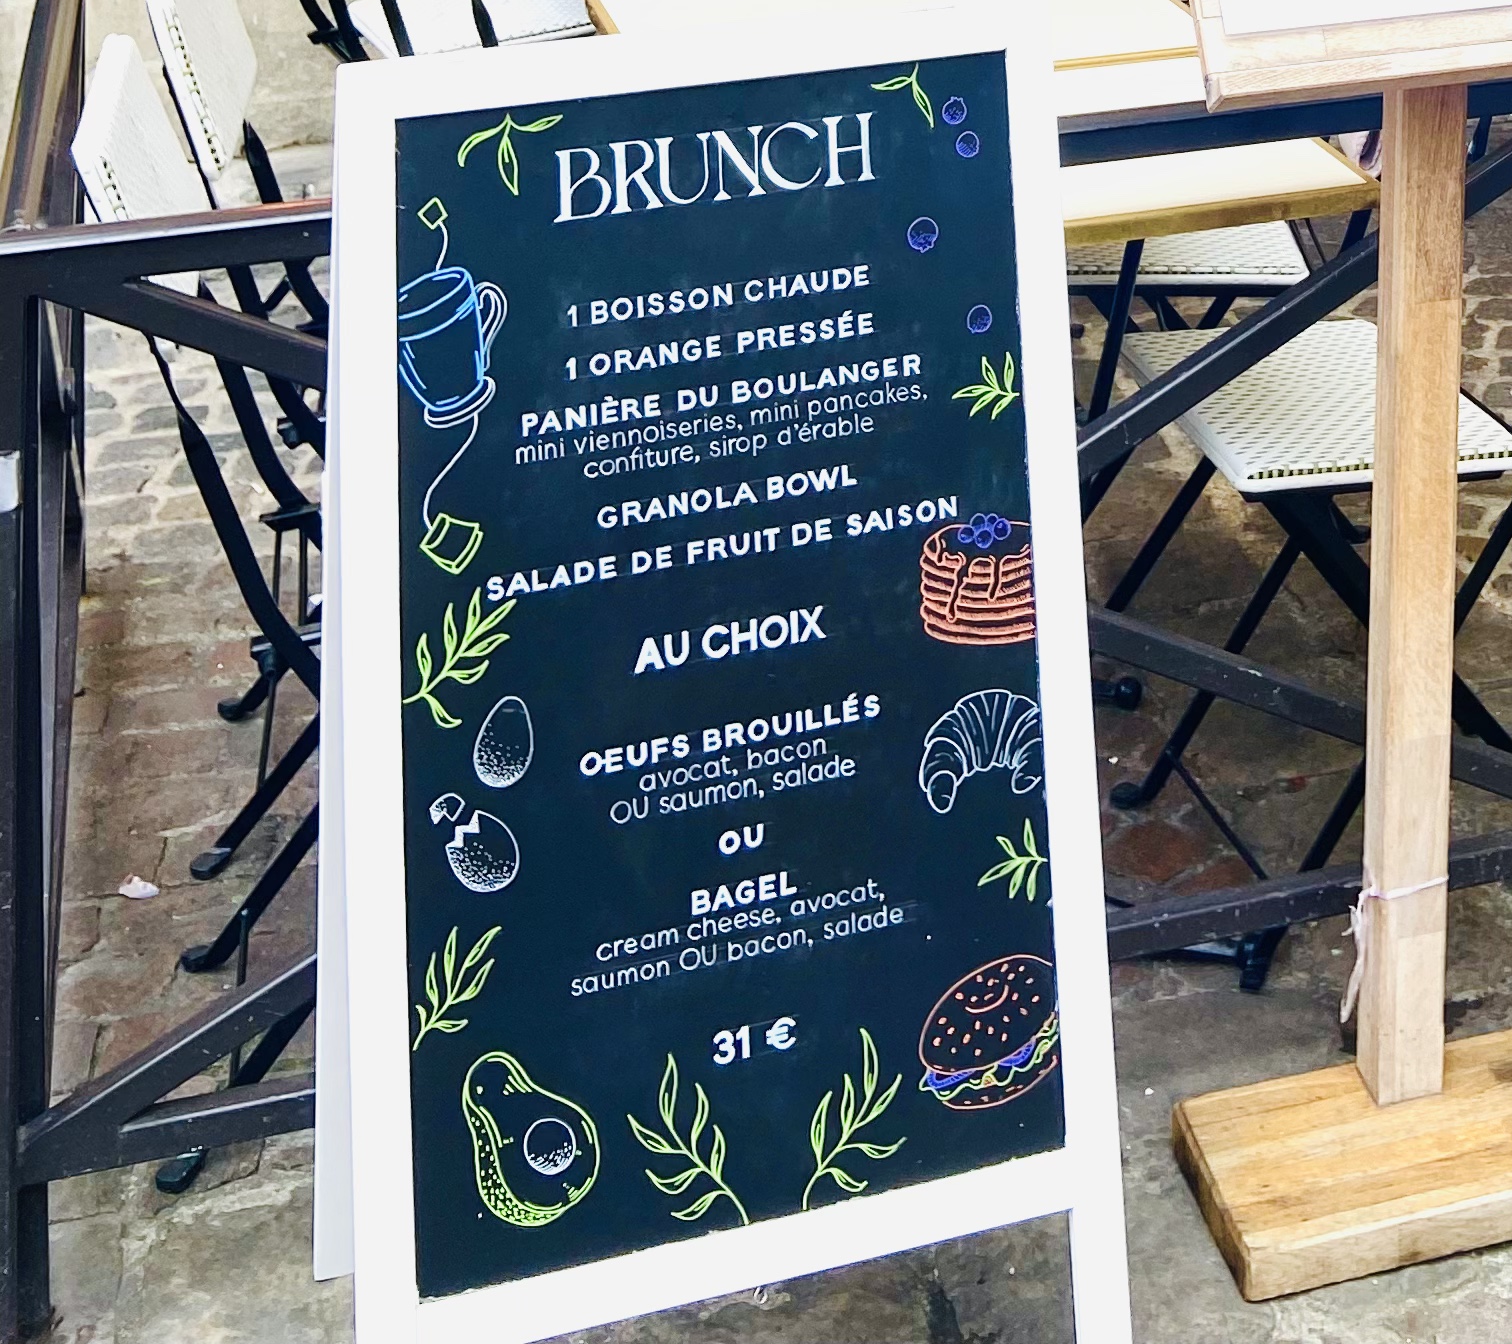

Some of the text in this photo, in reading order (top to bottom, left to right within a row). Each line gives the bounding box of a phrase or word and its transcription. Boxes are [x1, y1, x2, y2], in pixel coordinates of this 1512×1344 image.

[554, 112, 876, 224] BRUNCH
[567, 264, 871, 327] 1 BOISSON CHAUDE
[565, 311, 874, 380] 1 ORANGE PRESSÉE
[515, 381, 928, 465] mini viennoiseries, mini pancakes,
[520, 354, 922, 437] PANIÈRE DU BOULANGER
[583, 413, 875, 480] confiture, sirop d'érable
[597, 465, 857, 529] GRANOLA BOWL
[486, 496, 960, 601] SALADE DE FRUIT DE SAISON
[634, 605, 827, 675] AU CHOIX
[703, 692, 881, 753] BROUILLÉS
[610, 754, 856, 825] OU saumon, salade
[639, 737, 827, 793] avocat, bacon
[718, 824, 765, 857] OU
[596, 879, 885, 963] cream cheese, avocat,
[690, 872, 797, 916] BAGEL
[570, 904, 904, 997] saumon OU bacon, salade
[712, 1016, 797, 1065] 31 €
